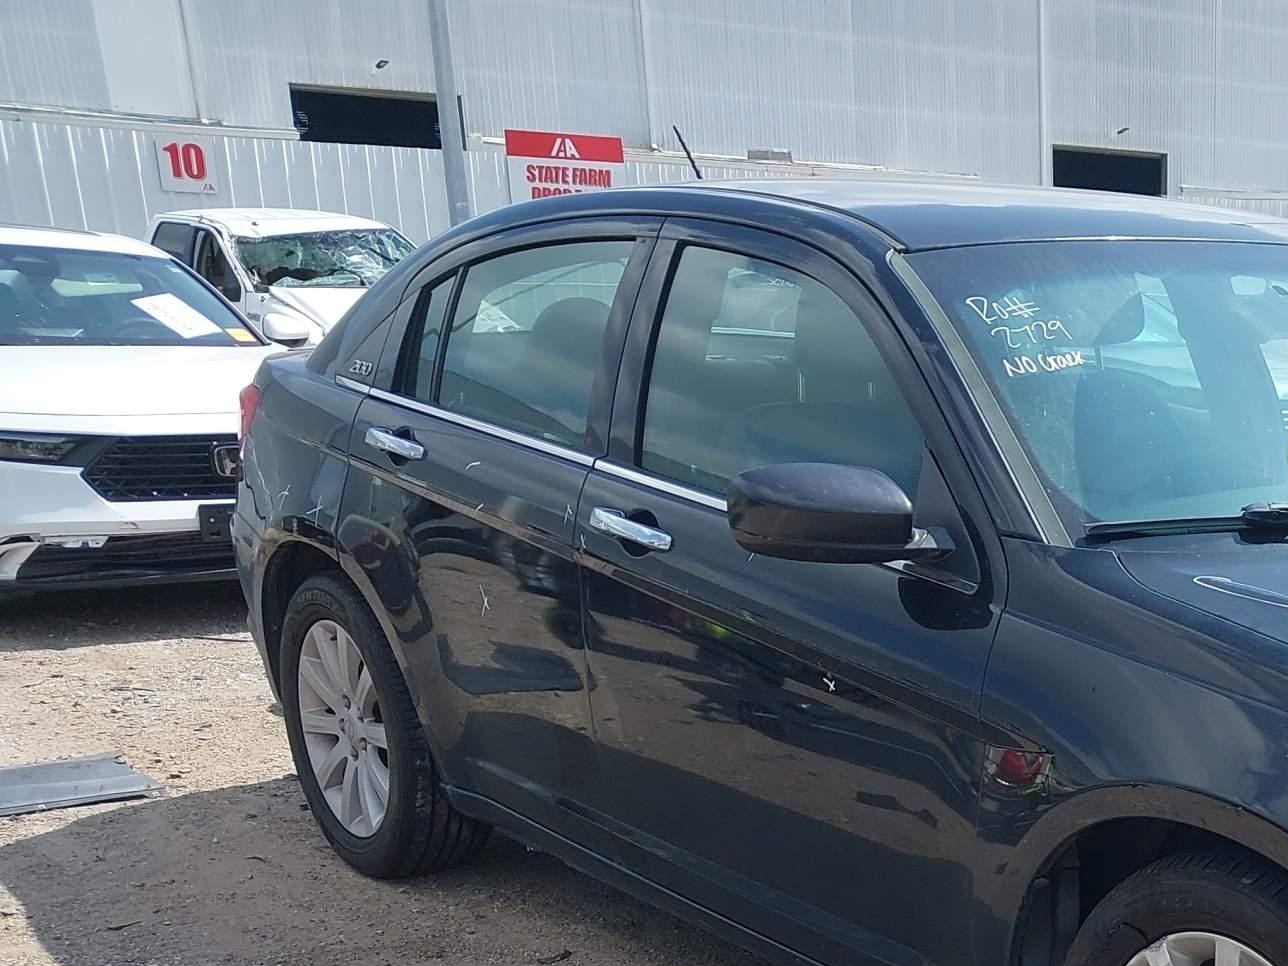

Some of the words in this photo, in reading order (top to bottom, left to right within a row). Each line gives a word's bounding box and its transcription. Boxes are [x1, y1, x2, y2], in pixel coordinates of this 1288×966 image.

[162, 142, 207, 180] 10
[526, 163, 570, 186] STATE
[571, 168, 612, 188] FARM
[531, 186, 574, 200] DRO
[990, 319, 1073, 349] 2729
[350, 359, 373, 377] 200
[1002, 355, 1038, 377] NO
